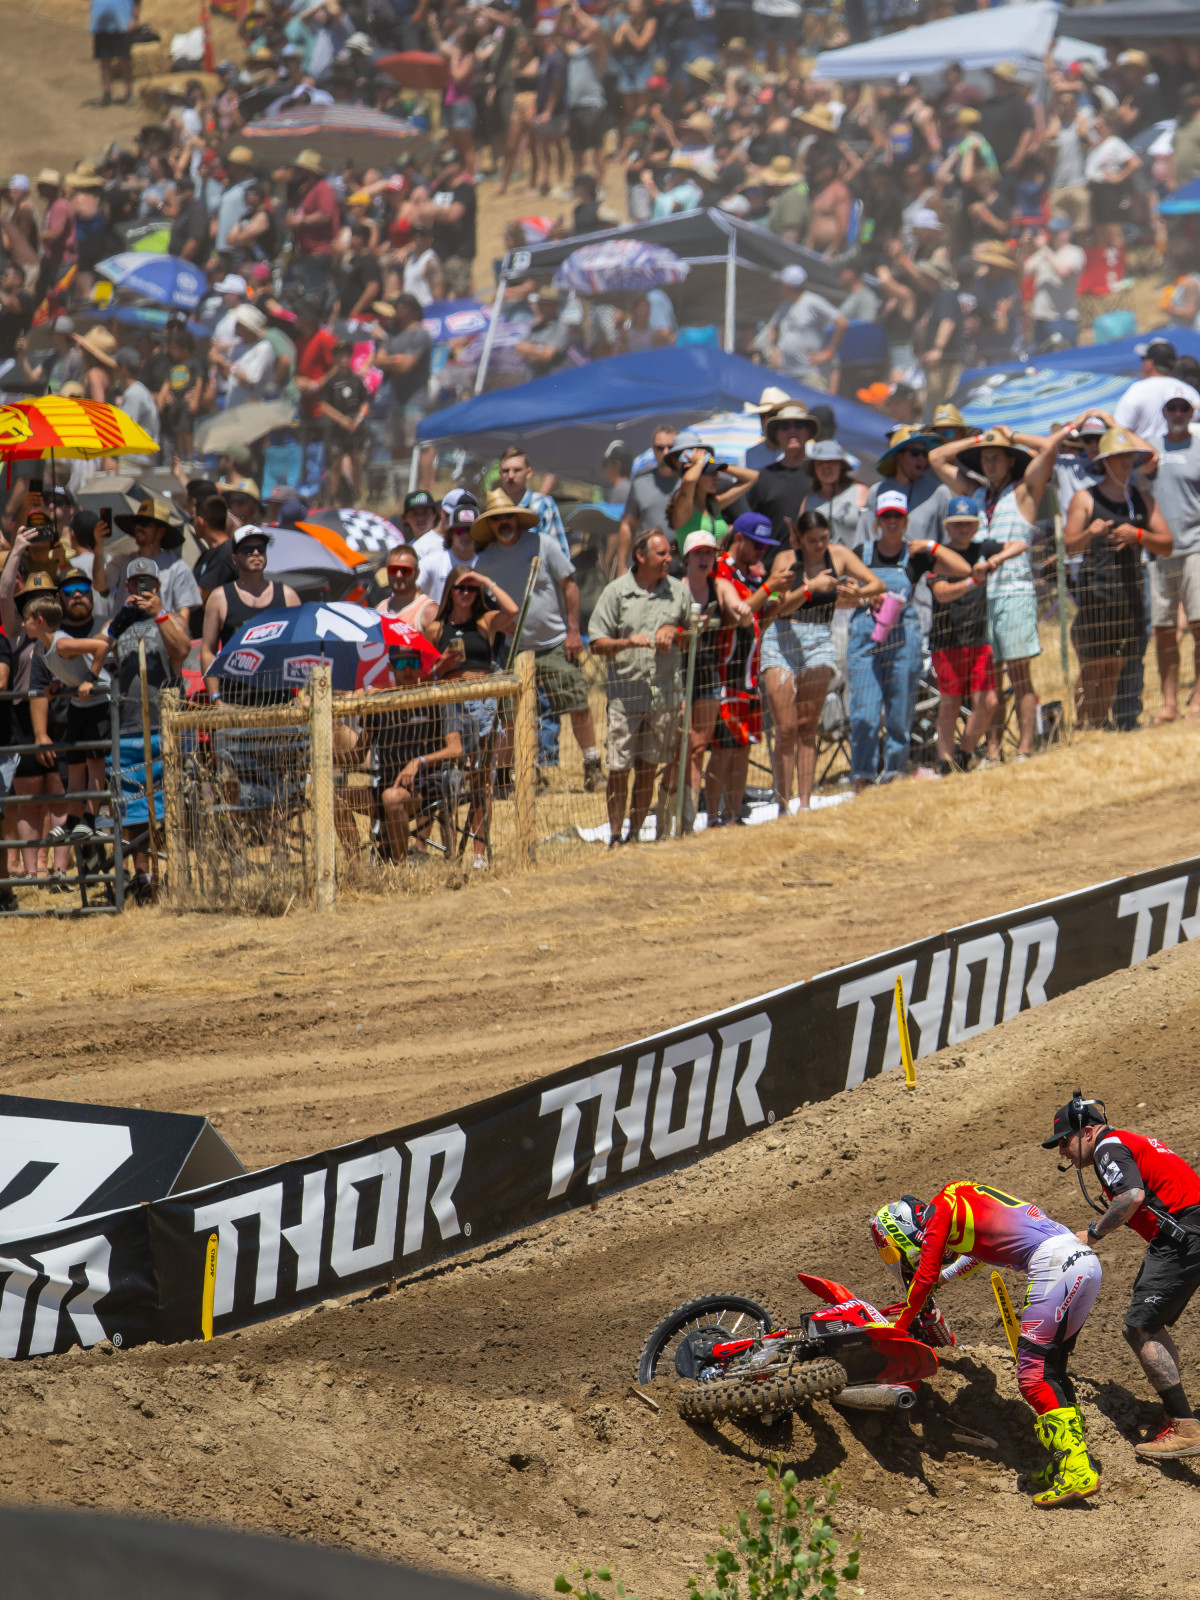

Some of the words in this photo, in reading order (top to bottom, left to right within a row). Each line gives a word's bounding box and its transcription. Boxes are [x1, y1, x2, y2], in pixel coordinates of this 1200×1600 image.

[837, 916, 1060, 1090] THOR
[539, 1012, 772, 1200] THOR
[194, 1124, 466, 1318] THOR
[1061, 1275, 1084, 1312] HONDA
